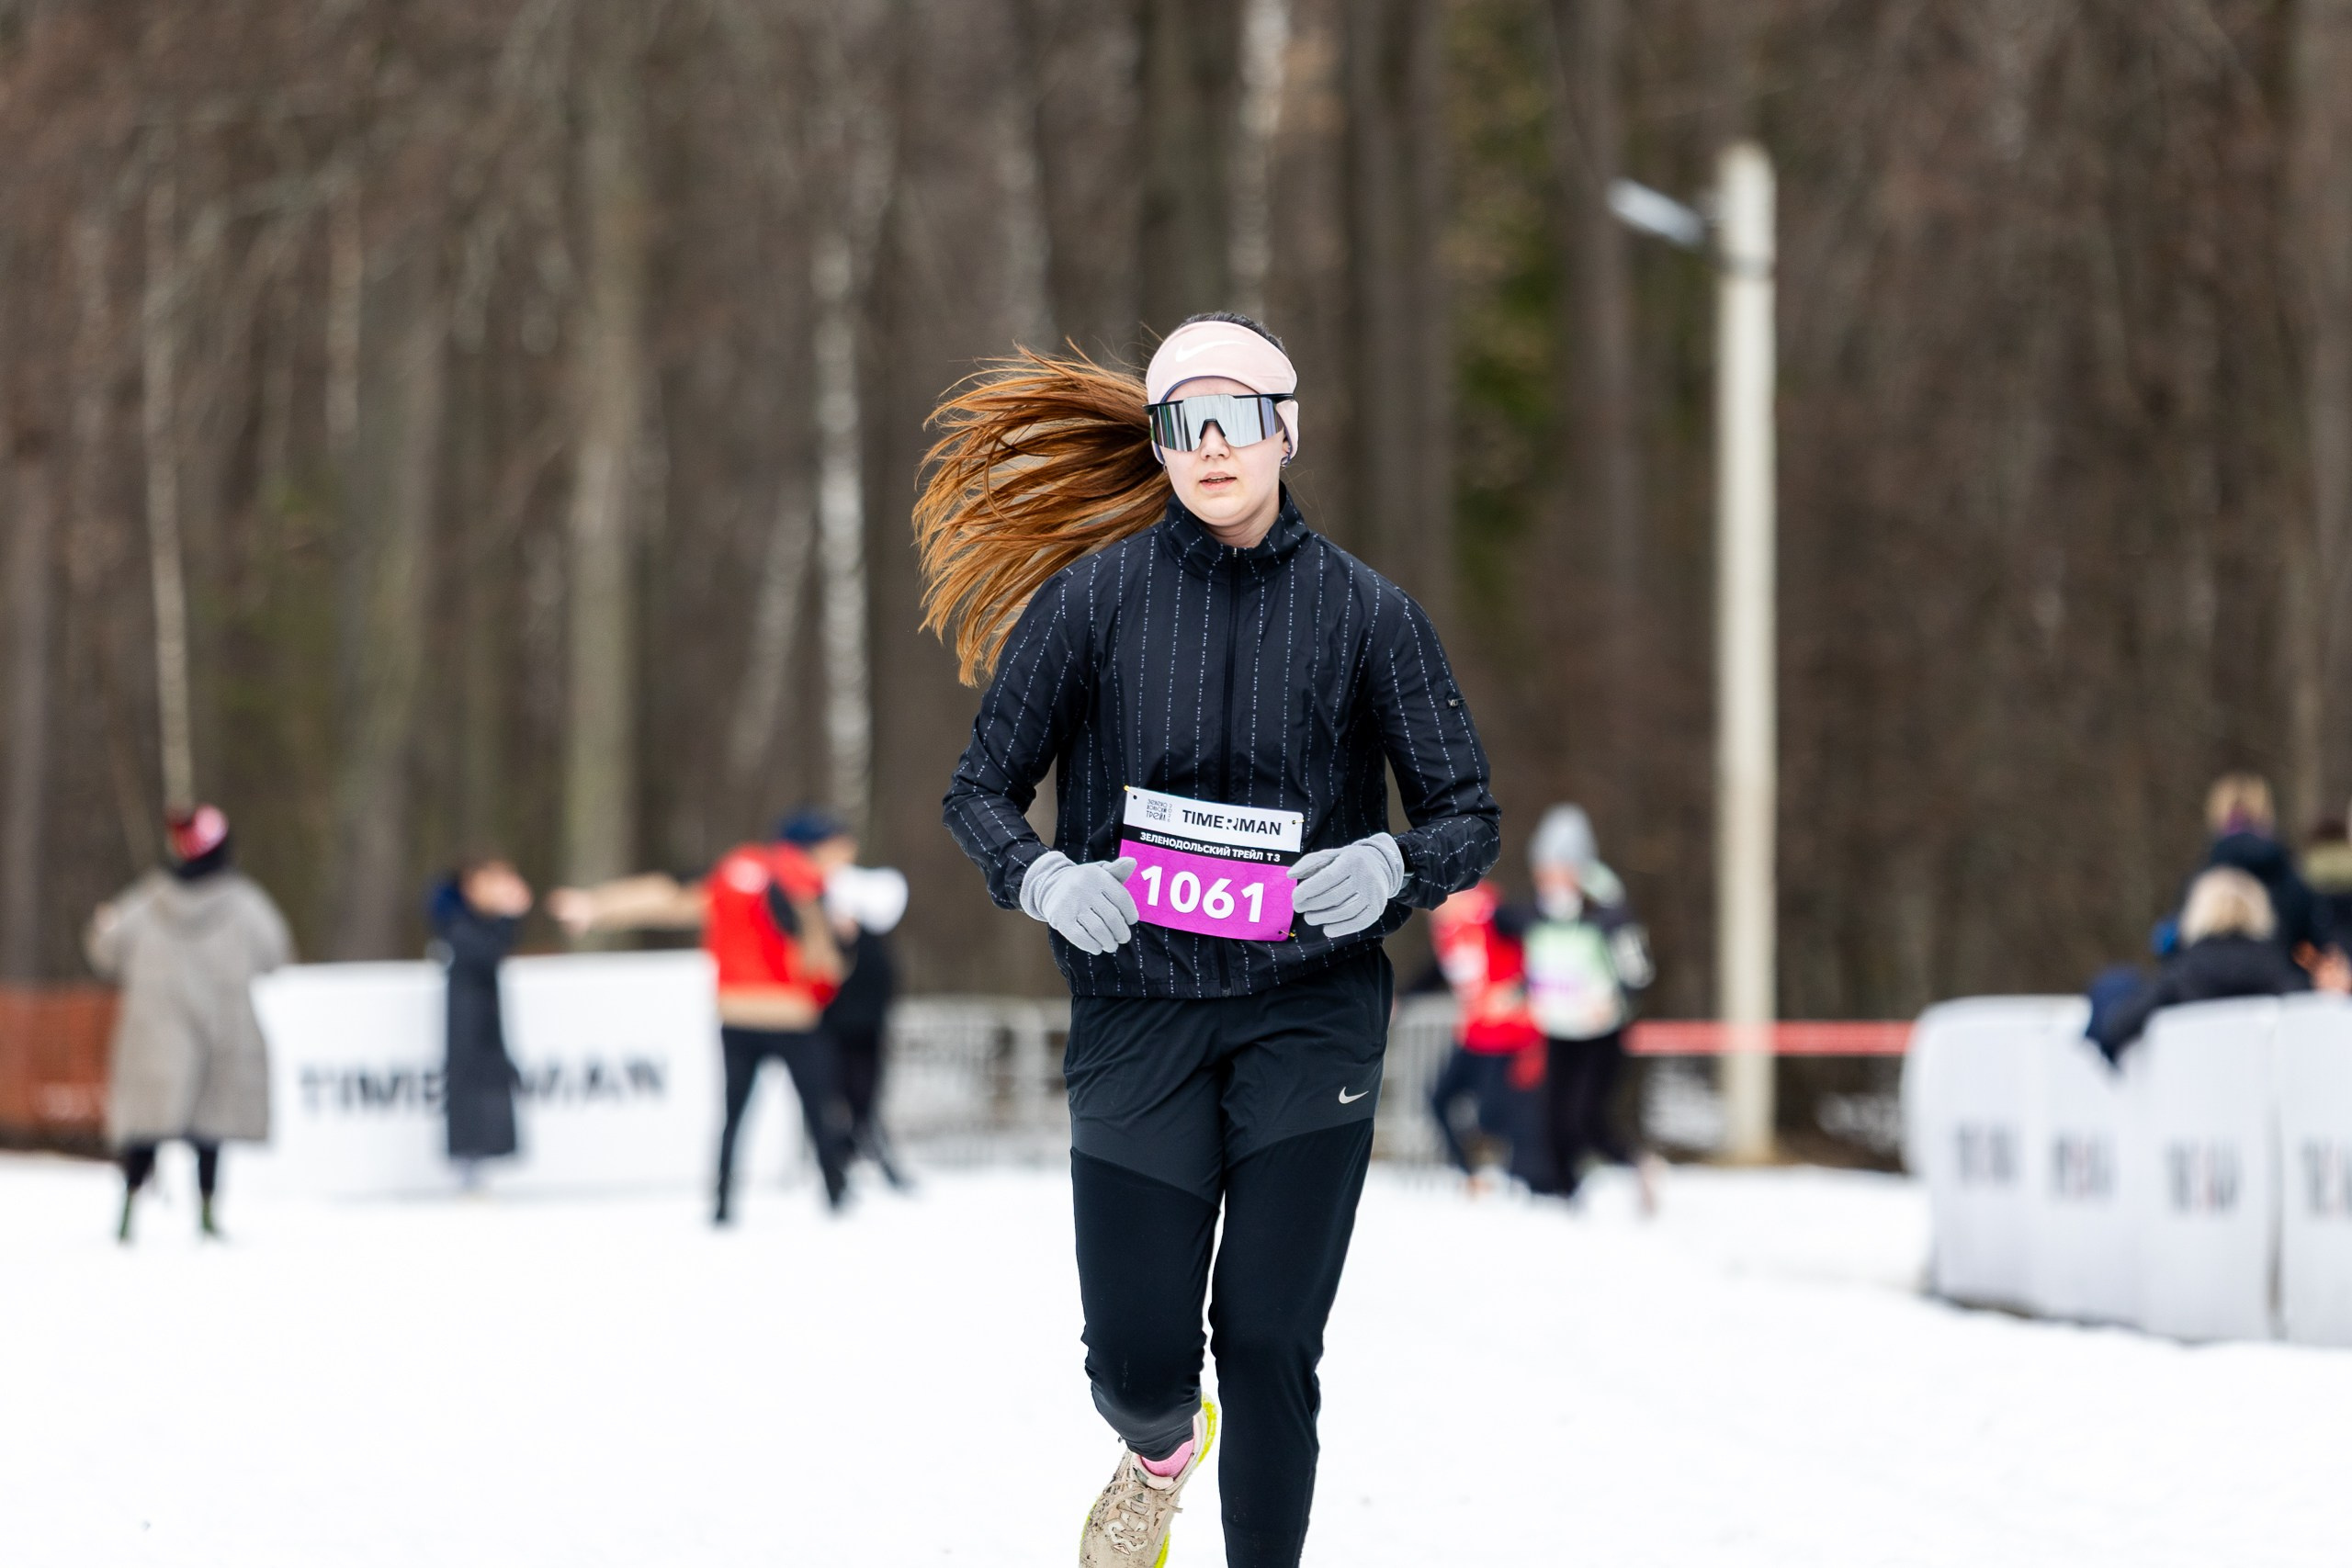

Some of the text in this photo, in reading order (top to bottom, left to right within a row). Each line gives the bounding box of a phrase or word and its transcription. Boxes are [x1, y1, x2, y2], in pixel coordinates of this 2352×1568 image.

[1139, 831, 1231, 857] ЗЕЛЕНОДОЛЬСКИЙ
[1232, 848, 1264, 861] ТРЕЙЛ
[1140, 865, 1264, 923] 1061
